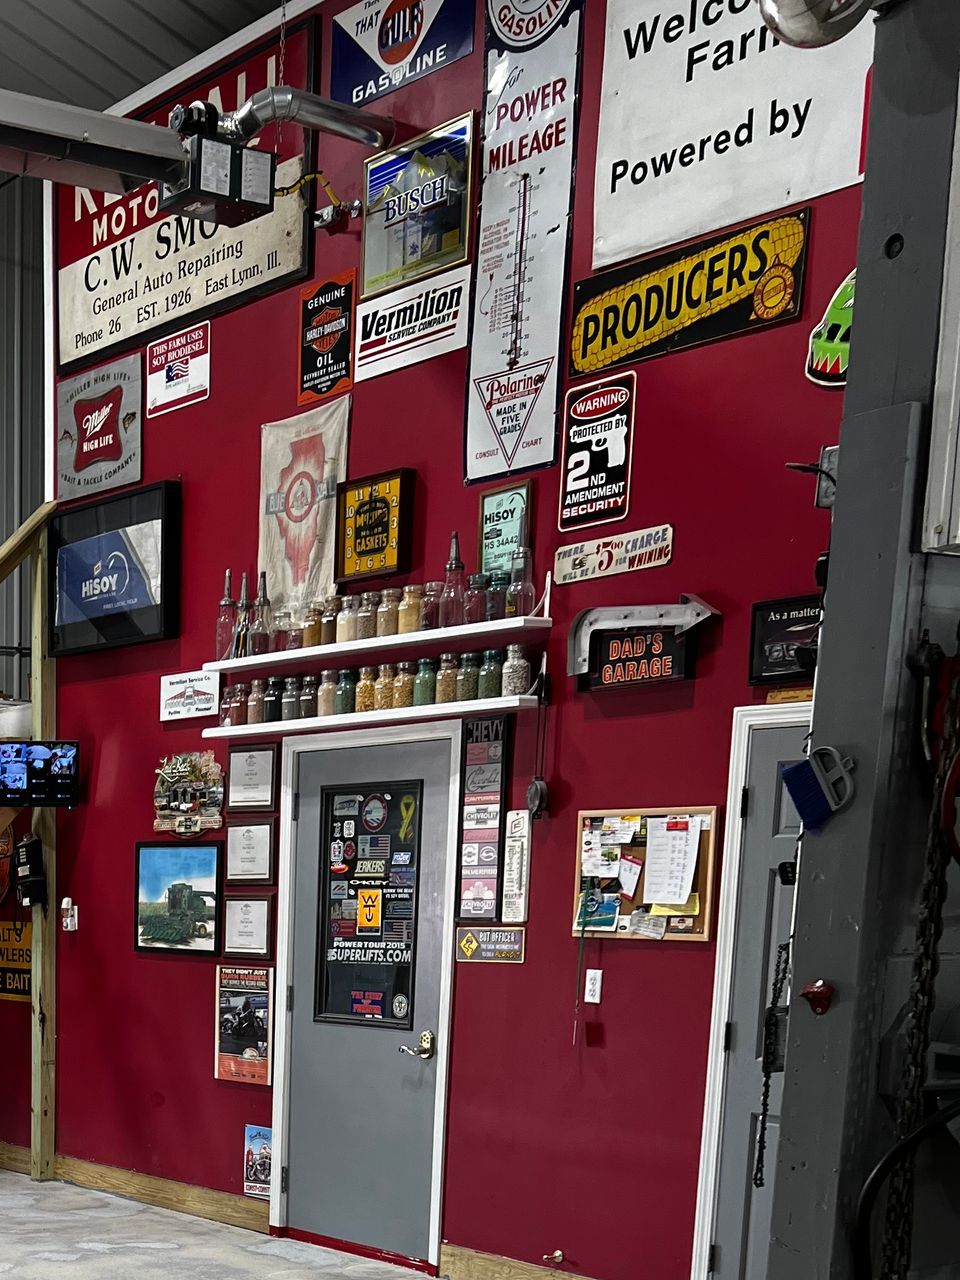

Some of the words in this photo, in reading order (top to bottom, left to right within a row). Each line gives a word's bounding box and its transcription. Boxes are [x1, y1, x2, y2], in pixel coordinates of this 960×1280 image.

[355, 10, 381, 37] THAT
[380, 2, 423, 50] GULF
[624, 0, 753, 60] Welco
[352, 43, 447, 104] GASOLINE
[488, 65, 524, 115] for
[495, 78, 568, 130] POWER
[489, 118, 567, 174] MILEAGE
[610, 107, 754, 194] Powered
[769, 98, 813, 139] by
[384, 175, 448, 223] BUSCH
[92, 195, 159, 247] MOTO
[154, 215, 220, 260] SMO
[92, 285, 139, 316] General
[142, 270, 173, 296] Auto
[177, 240, 244, 280] Repairing
[75, 328, 104, 349] Phone
[108, 316, 122, 336] 26
[136, 301, 161, 324] EST.
[164, 287, 192, 315] 1926
[205, 271, 229, 297] East
[231, 260, 263, 286] Lynn,
[266, 250, 281, 271] Ill.
[307, 287, 346, 310] GENUINE
[581, 229, 771, 360] PRODUCERS
[361, 286, 463, 341] Vermilion
[306, 317, 346, 341] HARLEY-DAVIDSON
[388, 324, 416, 343] SERVICE
[418, 312, 452, 332] COMPANY
[152, 354, 166, 368] SOY
[167, 340, 205, 361] BIODIESEL
[153, 343, 168, 356] THIS
[168, 335, 186, 350] FARM
[187, 330, 203, 342] USES
[316, 353, 334, 368] OIL
[486, 374, 545, 400] Polarine
[496, 403, 517, 417] MADE
[519, 401, 527, 411] IN
[575, 391, 627, 413] WARNING
[82, 403, 113, 438] Miller
[499, 422, 522, 435] GRADES
[501, 413, 521, 426] FIVE
[572, 421, 613, 440] PROTECTED
[615, 415, 626, 428] BY
[83, 438, 99, 453] HIGH
[99, 434, 114, 448] LIFE
[475, 448, 499, 460] CONSULT
[522, 437, 543, 449] CHART
[83, 473, 103, 485] TACKLE
[104, 456, 133, 481] COMPANY
[566, 450, 606, 492] 2ND
[355, 488, 364, 501] 11
[385, 482, 390, 493] 1
[391, 496, 398, 507] 2
[565, 482, 625, 506] AMENDMENT
[345, 506, 355, 518] 10
[484, 507, 516, 525] HiSOY
[562, 496, 625, 519] SECURITY
[346, 527, 353, 538] 9
[391, 517, 397, 529] 3
[356, 533, 388, 552] GASKETS
[390, 538, 396, 549] 4
[484, 541, 495, 550] HS
[624, 527, 668, 554] CHARGE
[346, 547, 352, 558] 8
[355, 560, 361, 571] 7
[367, 557, 374, 568] 6
[380, 555, 386, 566] 5
[557, 544, 585, 561] THERE
[615, 556, 627, 566] FOR
[628, 544, 671, 569] WHINING
[562, 571, 577, 581] WILL
[580, 568, 589, 577] BE
[591, 566, 596, 575] A
[82, 573, 119, 598] HiSOY
[768, 611, 781, 621] As
[782, 612, 788, 620] a
[789, 607, 820, 619] matter
[609, 632, 663, 661] DAD'S
[602, 655, 673, 684] GARAGE
[467, 720, 504, 743] CHEVY
[466, 811, 498, 820] CHEVROLET
[355, 860, 386, 873] JERKERS
[461, 866, 498, 877] SILVERADO
[480, 931, 491, 942] BUT
[491, 931, 515, 942] OFFICER
[332, 949, 411, 963] SUPERLIFTS.COM
[5, 972, 31, 989] BAIT
